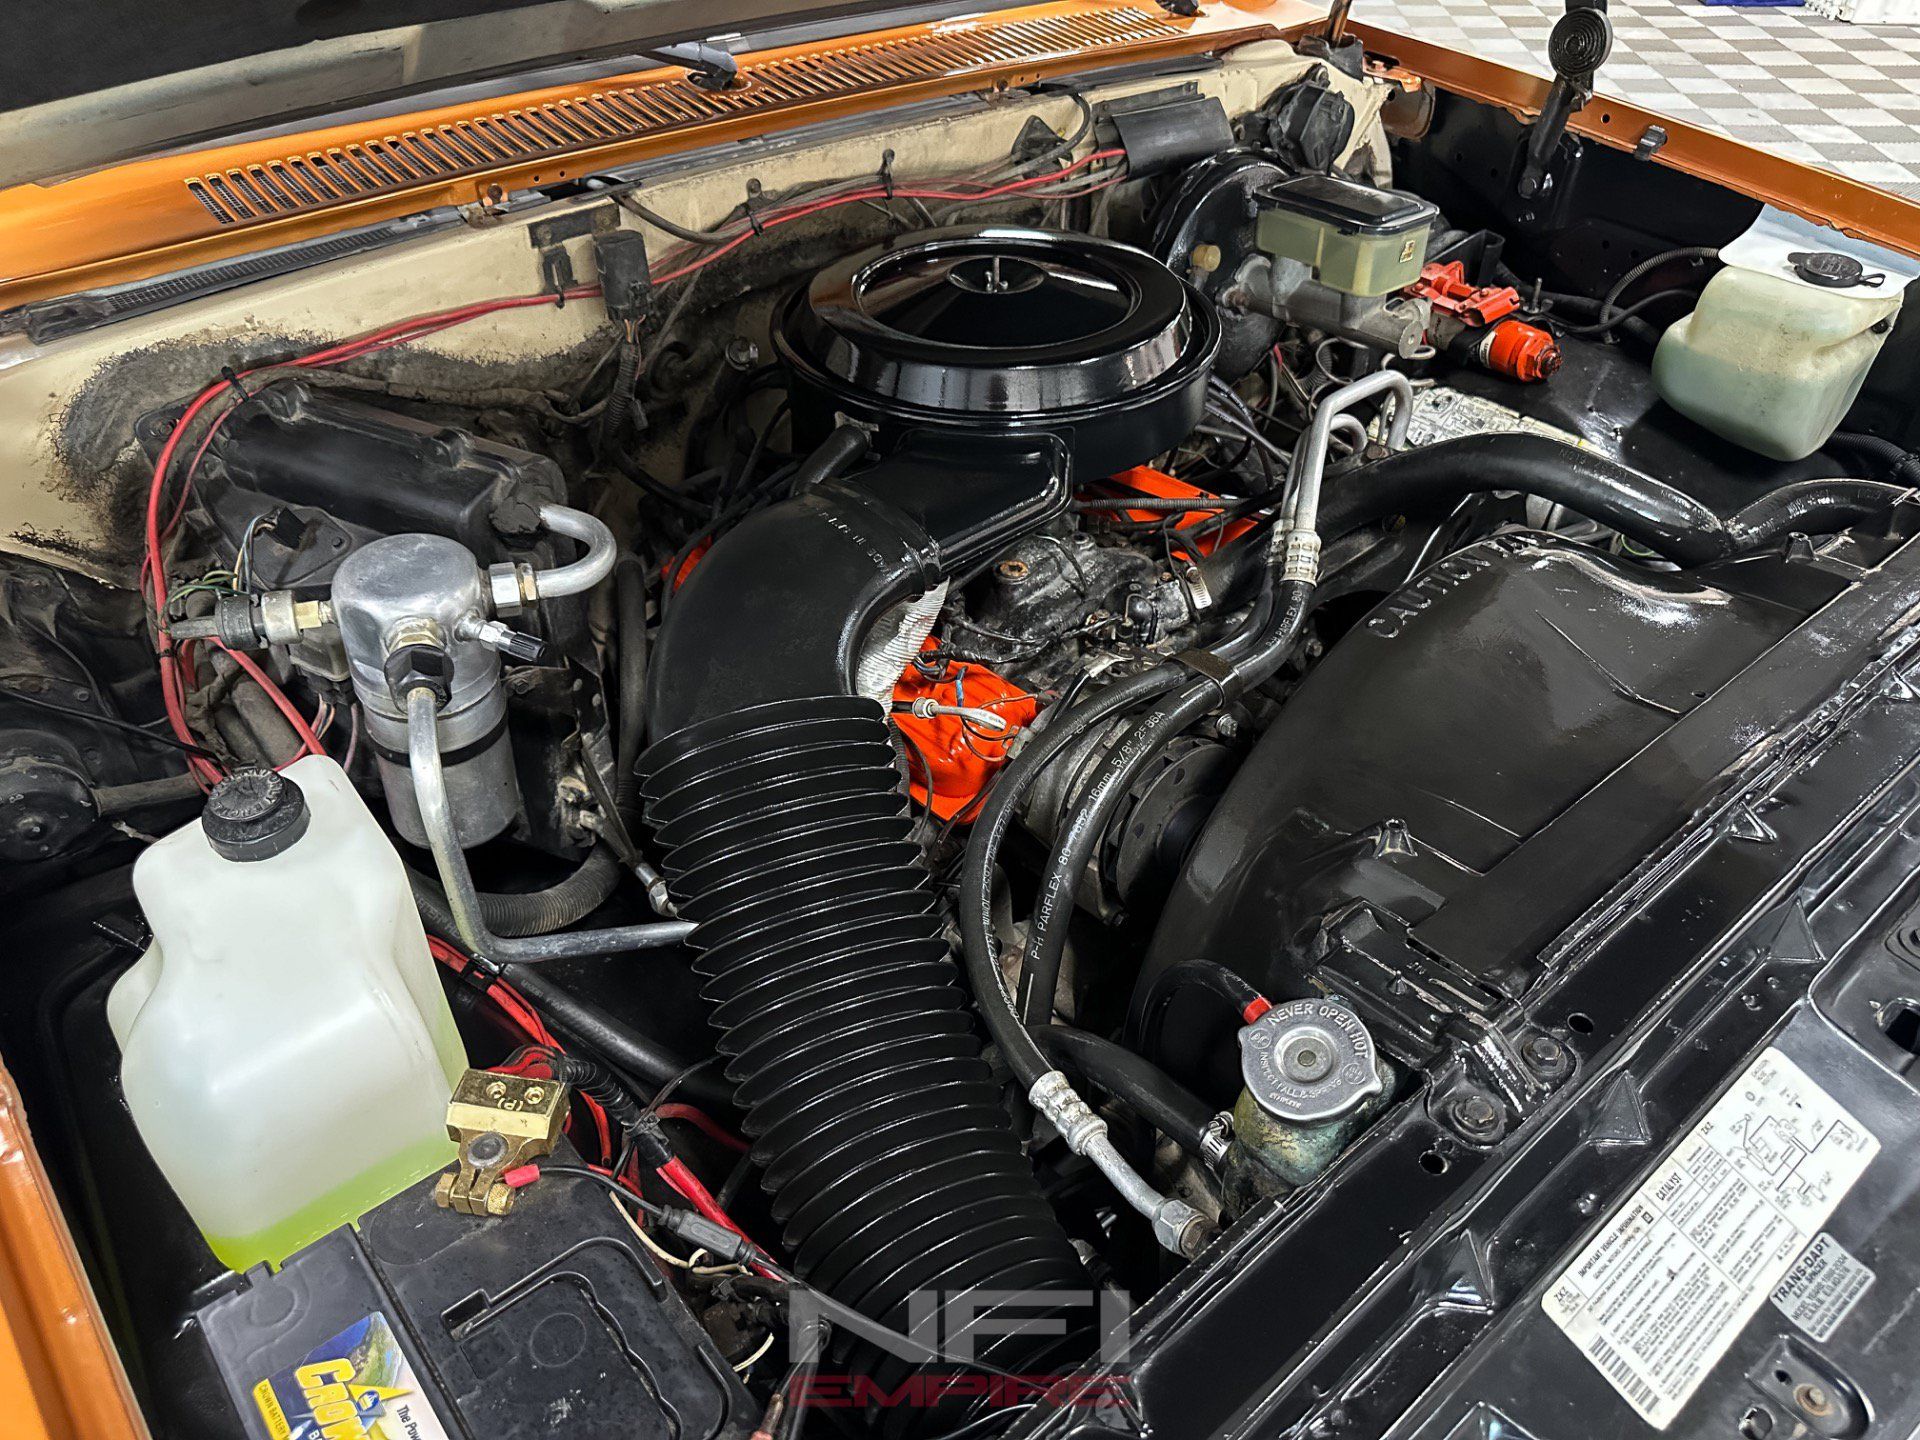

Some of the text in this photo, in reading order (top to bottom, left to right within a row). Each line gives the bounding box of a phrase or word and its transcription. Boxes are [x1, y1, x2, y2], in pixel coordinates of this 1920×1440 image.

[1275, 604, 1299, 638] PARFLEX
[1289, 588, 1304, 604] 80
[1365, 552, 1492, 639] CAUTION
[1087, 772, 1112, 804] 16mm
[1058, 847, 1073, 866] 80
[1037, 870, 1063, 932] PARFLEX
[1031, 937, 1044, 960] P-H
[1267, 1003, 1369, 1059] NEVER OPEN HOT
[1656, 1171, 1682, 1202] CATALYST
[1576, 1202, 1645, 1278] IMPORTANT VEHICLE INFORMATION
[1772, 1237, 1831, 1303] TRANS-DAPT
[1803, 1257, 1829, 1284] SPACER
[396, 1403, 411, 1424] The
